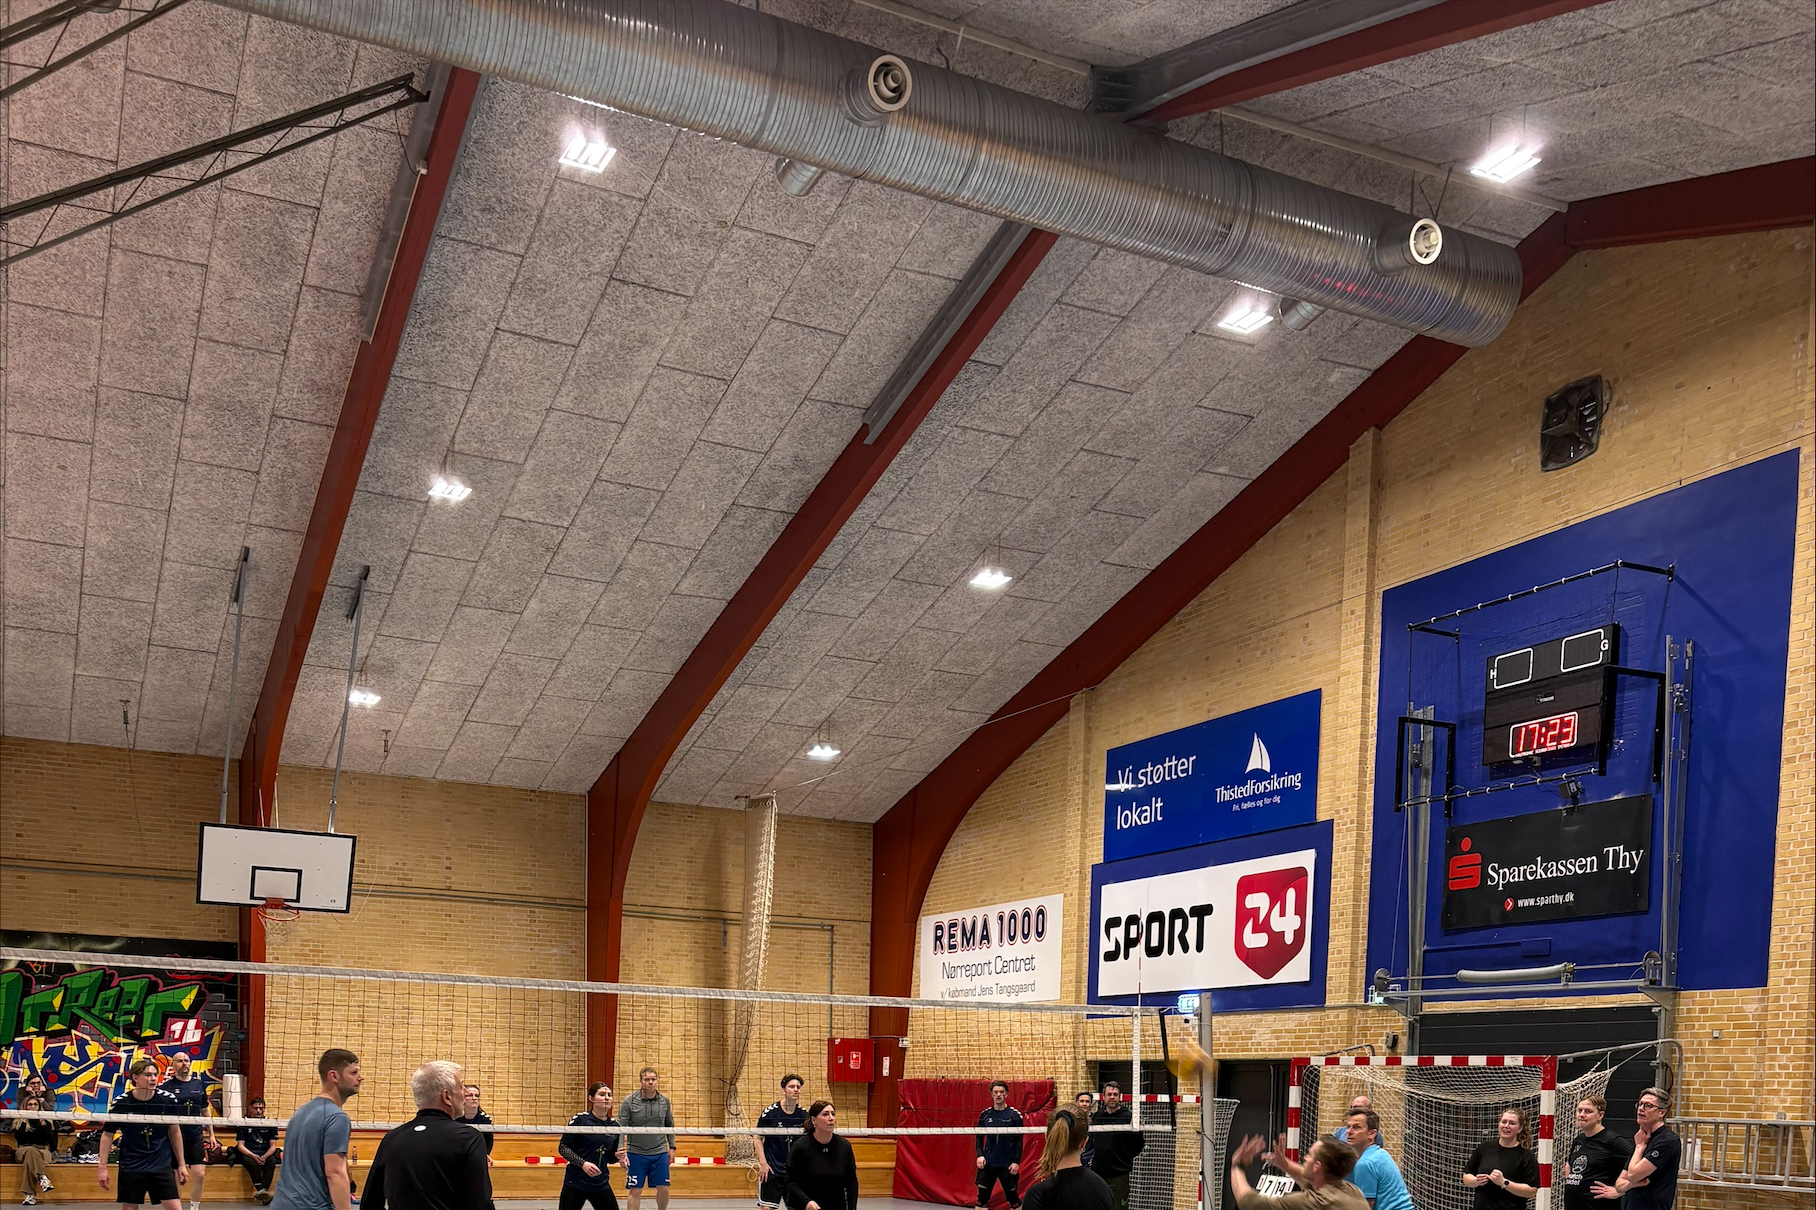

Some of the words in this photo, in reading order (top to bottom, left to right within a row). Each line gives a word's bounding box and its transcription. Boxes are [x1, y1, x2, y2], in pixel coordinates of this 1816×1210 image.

[1600, 639, 1609, 650] G
[1489, 668, 1497, 679] H
[1518, 715, 1575, 752] 17:23
[1118, 765, 1132, 792] Vi
[1137, 754, 1197, 788] støtter
[1215, 771, 1302, 803] ThistedForsikring
[1116, 796, 1164, 831] lokalt
[1487, 855, 1599, 891] Sparekassen
[1603, 844, 1645, 874] Thy
[1517, 891, 1575, 907] www.sparthy.dk
[933, 914, 992, 955] REMA
[997, 905, 1048, 947] 1000
[1103, 903, 1214, 962] SPORT
[1243, 887, 1301, 949] 24
[942, 959, 993, 982] Nørreport
[994, 954, 1036, 975] Centret
[948, 985, 977, 999] købmand
[977, 985, 994, 998] Jens
[995, 980, 1036, 997] Tangsgaard
[1264, 1180, 1273, 1193] 7
[1274, 1181, 1287, 1195] 14
